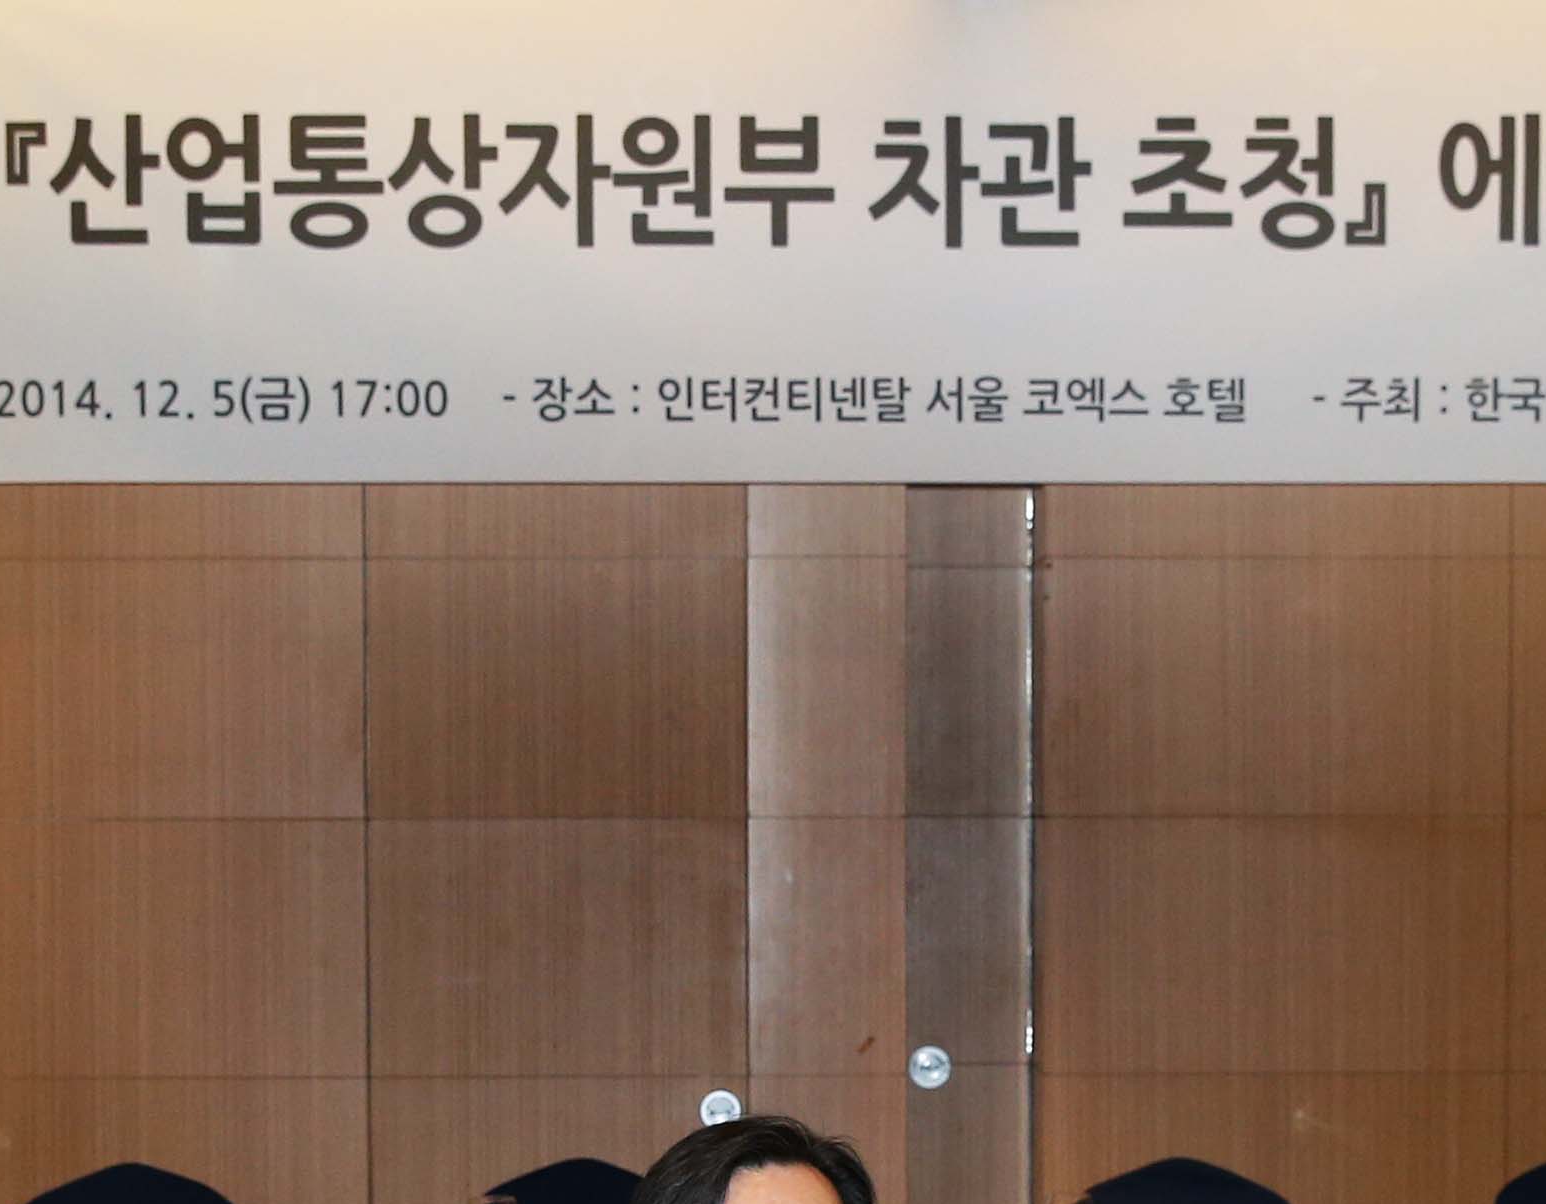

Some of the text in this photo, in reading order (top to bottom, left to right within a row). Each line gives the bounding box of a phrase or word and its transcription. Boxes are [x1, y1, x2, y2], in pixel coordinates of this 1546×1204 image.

[867, 114, 1093, 250] 차관
[1122, 115, 1387, 251] 초청』
[133, 378, 195, 421] 12.
[213, 375, 312, 425] 5(금)
[330, 378, 449, 419] 17:00
[531, 375, 616, 423] 장소
[657, 375, 912, 424] 인터컨티넨탈
[926, 375, 1010, 424] 서울
[1022, 376, 1150, 424] 코엑스
[1162, 377, 1246, 424] 호텔
[1340, 375, 1421, 424] 주최
